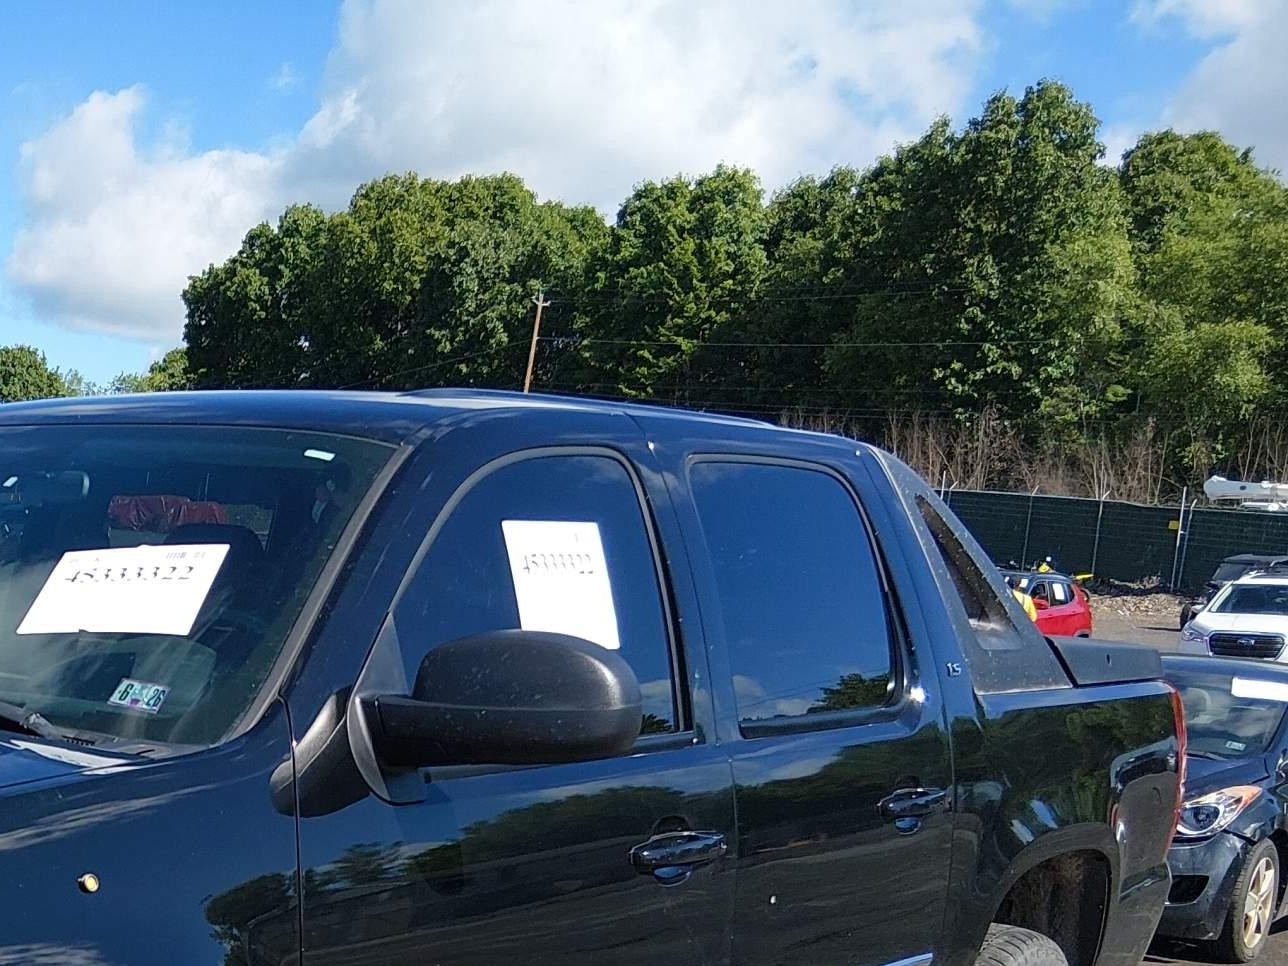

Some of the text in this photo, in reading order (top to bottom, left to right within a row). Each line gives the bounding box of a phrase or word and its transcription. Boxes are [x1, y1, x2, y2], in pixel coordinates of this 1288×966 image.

[64, 565, 195, 585] 45333322
[118, 682, 167, 708] 6 26
